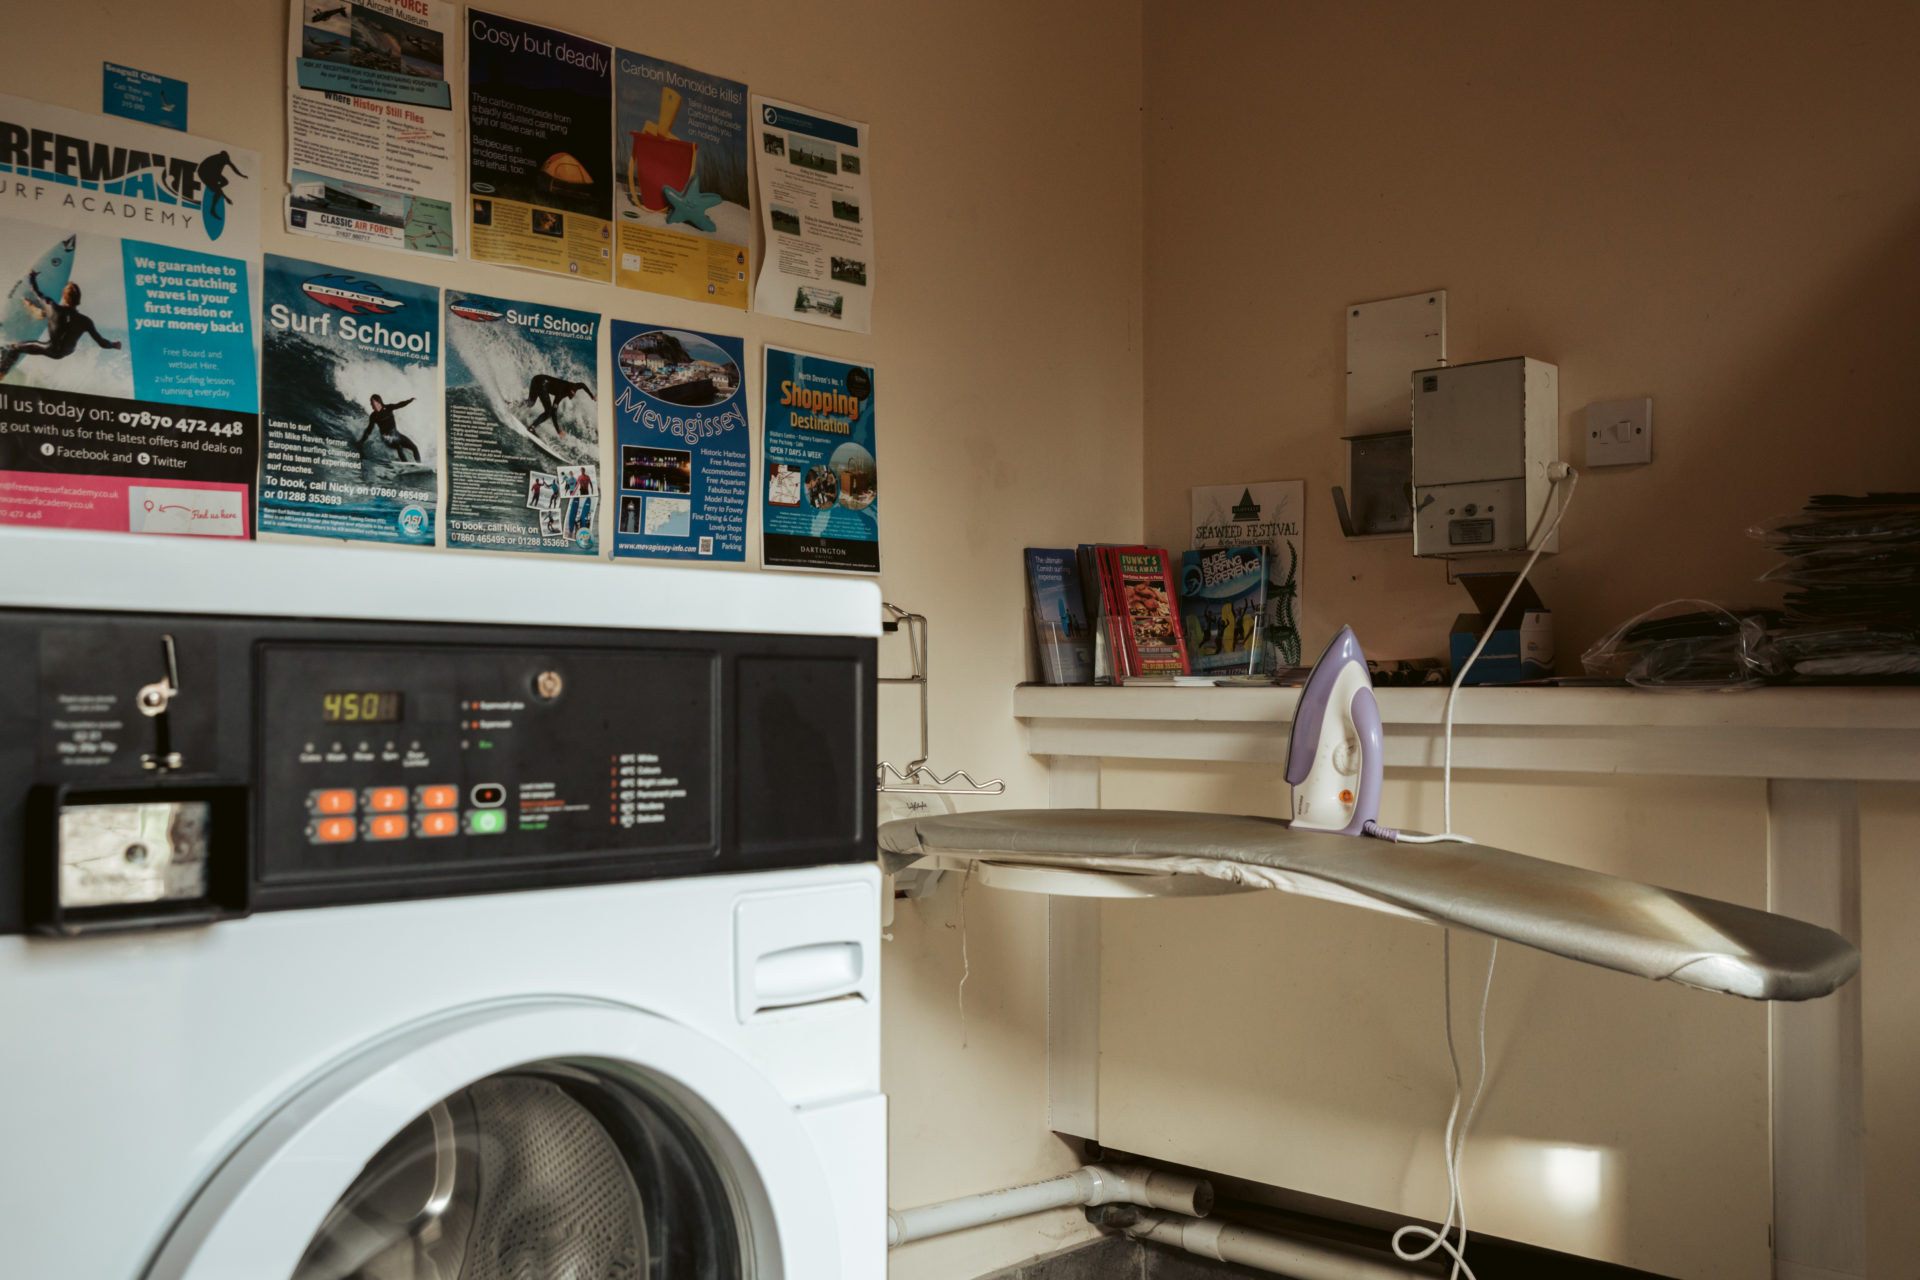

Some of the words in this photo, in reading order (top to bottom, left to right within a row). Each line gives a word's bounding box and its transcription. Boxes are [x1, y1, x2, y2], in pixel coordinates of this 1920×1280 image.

[366, 0, 396, 18] Aircraft
[395, 9, 429, 28] Museum
[472, 20, 520, 53] Cosy
[524, 32, 552, 58] but
[555, 42, 608, 78] deadly
[621, 58, 664, 81] Carbon
[666, 71, 718, 98] Monoxide
[719, 87, 743, 104] kills!
[325, 91, 351, 105] Where
[352, 97, 383, 115] History
[386, 104, 403, 118] Still
[404, 111, 425, 124] Flies
[472, 135, 514, 152] Barbecues
[63, 193, 193, 229] ACADEMY
[320, 214, 353, 229] CLASSIC
[354, 221, 368, 232] AIR
[370, 224, 394, 236] FORCE
[133, 256, 156, 269] We
[158, 261, 221, 275] guarantee
[223, 265, 236, 276] to
[135, 273, 158, 286] get
[160, 277, 183, 288] you
[185, 278, 238, 294] catching
[146, 289, 185, 300] waves
[187, 290, 199, 302] in
[201, 294, 230, 305] your
[144, 302, 172, 314] first
[173, 306, 217, 318] session
[219, 310, 234, 318] or
[135, 318, 166, 330] your
[167, 320, 208, 334] money
[210, 320, 244, 334] back!
[270, 303, 331, 336] Surf
[338, 316, 431, 354] School
[506, 309, 540, 327] Surf
[543, 315, 594, 335] School
[530, 328, 592, 341] www.ravensurf.co.uk
[163, 347, 180, 357] Free
[182, 349, 206, 358] Board
[208, 350, 223, 358] and
[358, 344, 430, 361] www.ravensurf.co.uk
[168, 361, 198, 369] wetsuit
[176, 375, 205, 386] Surfing
[161, 388, 193, 398] running
[194, 389, 230, 399] everyday
[780, 380, 859, 420] Shopping
[13, 399, 33, 413] us
[39, 400, 84, 422] today
[89, 408, 115, 423] on:
[118, 411, 173, 430] 07870
[175, 418, 207, 434] 472
[209, 421, 243, 437] 448
[615, 386, 747, 445] Mevagissey
[790, 411, 850, 435] Destination
[268, 418, 288, 430] Learn
[298, 424, 312, 432] surf
[10, 422, 31, 433] out
[34, 423, 59, 436] with
[62, 428, 75, 438] us
[77, 428, 93, 440] for
[97, 431, 114, 442] the
[117, 432, 147, 445] latest
[149, 435, 179, 449] offers
[181, 439, 199, 450] and
[202, 441, 227, 454] deals
[229, 446, 242, 455] on
[268, 430, 284, 438] with
[284, 432, 301, 441] Mike
[301, 434, 325, 444] Raven,
[326, 438, 348, 447] former
[57, 446, 110, 462] Facebook
[112, 451, 132, 463] and
[152, 455, 188, 469] Twitter
[268, 441, 302, 452] European
[303, 445, 327, 457] surfing
[328, 448, 360, 459] champion
[700, 448, 722, 457] Historic
[723, 449, 746, 459] Harbour
[267, 452, 282, 461] and
[282, 453, 294, 462] his
[295, 455, 312, 463] team
[321, 459, 361, 469] experienced
[710, 458, 722, 466] Free
[723, 460, 746, 468] Museum
[267, 463, 281, 471] surf
[282, 465, 314, 475] coaches.
[701, 467, 746, 477] Accommodation
[266, 475, 278, 485] To
[280, 476, 308, 490] book,
[310, 481, 327, 490] call
[329, 482, 355, 495] Nicky
[356, 487, 369, 495] on
[370, 487, 397, 498] 07860
[398, 489, 429, 501] 465499
[706, 476, 719, 484] Free
[720, 478, 746, 486] Aquarium
[264, 490, 275, 499] or
[277, 490, 306, 502] 01288
[308, 492, 342, 505] 353693
[708, 486, 731, 494] Fabulous
[733, 487, 745, 495] Pubs
[704, 495, 722, 503] Model
[723, 497, 745, 506] Railway
[704, 504, 719, 514] Ferry
[726, 506, 744, 515] Fowey
[705, 514, 723, 522] Dining
[450, 520, 462, 529] To
[463, 521, 486, 533] book,
[487, 523, 503, 532] call
[504, 524, 527, 534] Nicky
[709, 524, 725, 532] Lovely
[1195, 525, 1243, 539] SEAWEED
[1246, 522, 1299, 537] FESTIVAL
[451, 533, 475, 542] 07860
[476, 534, 505, 544] 465499
[518, 538, 541, 546] 01288
[543, 538, 569, 548] 353693
[715, 533, 728, 541] Boat
[729, 534, 742, 542] Trips
[722, 543, 742, 552] Parking
[800, 546, 846, 556] DARTINGTON
[1122, 555, 1157, 566] FUNKY'S
[1202, 551, 1226, 567] BUDE
[1203, 555, 1242, 578] SURFING
[1205, 558, 1261, 588] EXPERIENCE
[324, 693, 379, 720] 450
